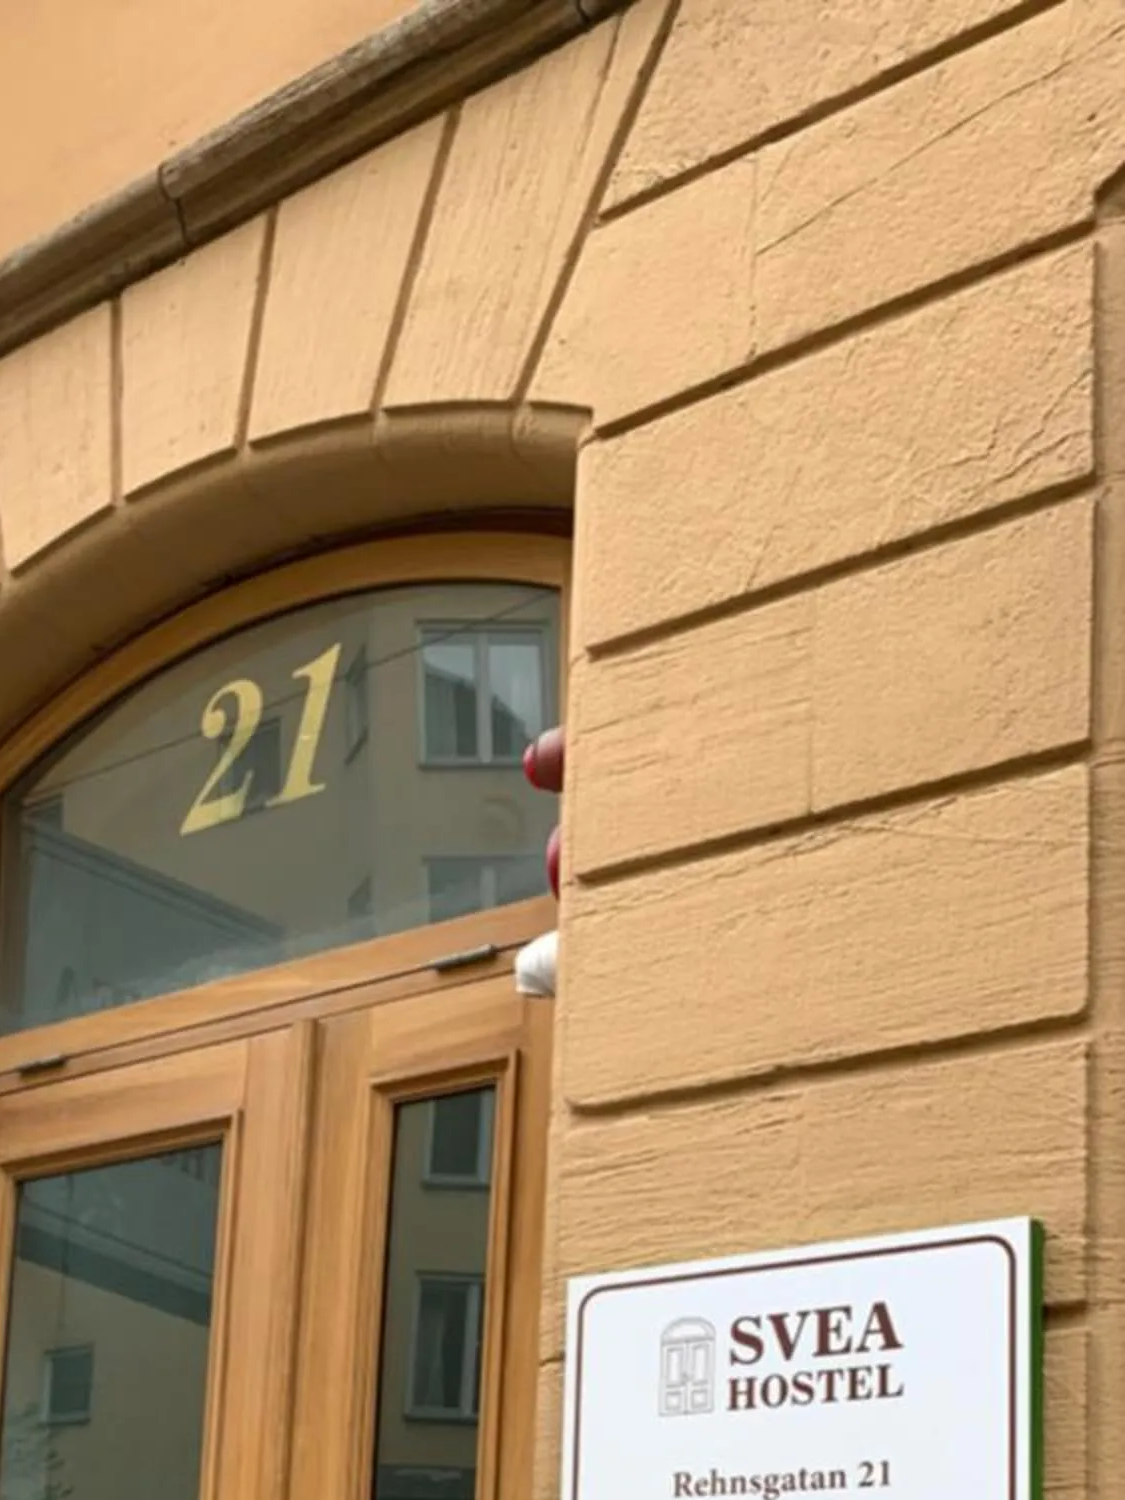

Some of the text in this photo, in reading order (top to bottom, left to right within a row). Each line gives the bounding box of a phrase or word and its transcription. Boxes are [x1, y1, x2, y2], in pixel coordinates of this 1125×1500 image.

[180, 642, 343, 837] 21
[728, 1301, 904, 1366] SVEA
[726, 1363, 905, 1412] HOSTEL
[858, 1459, 892, 1488] 21
